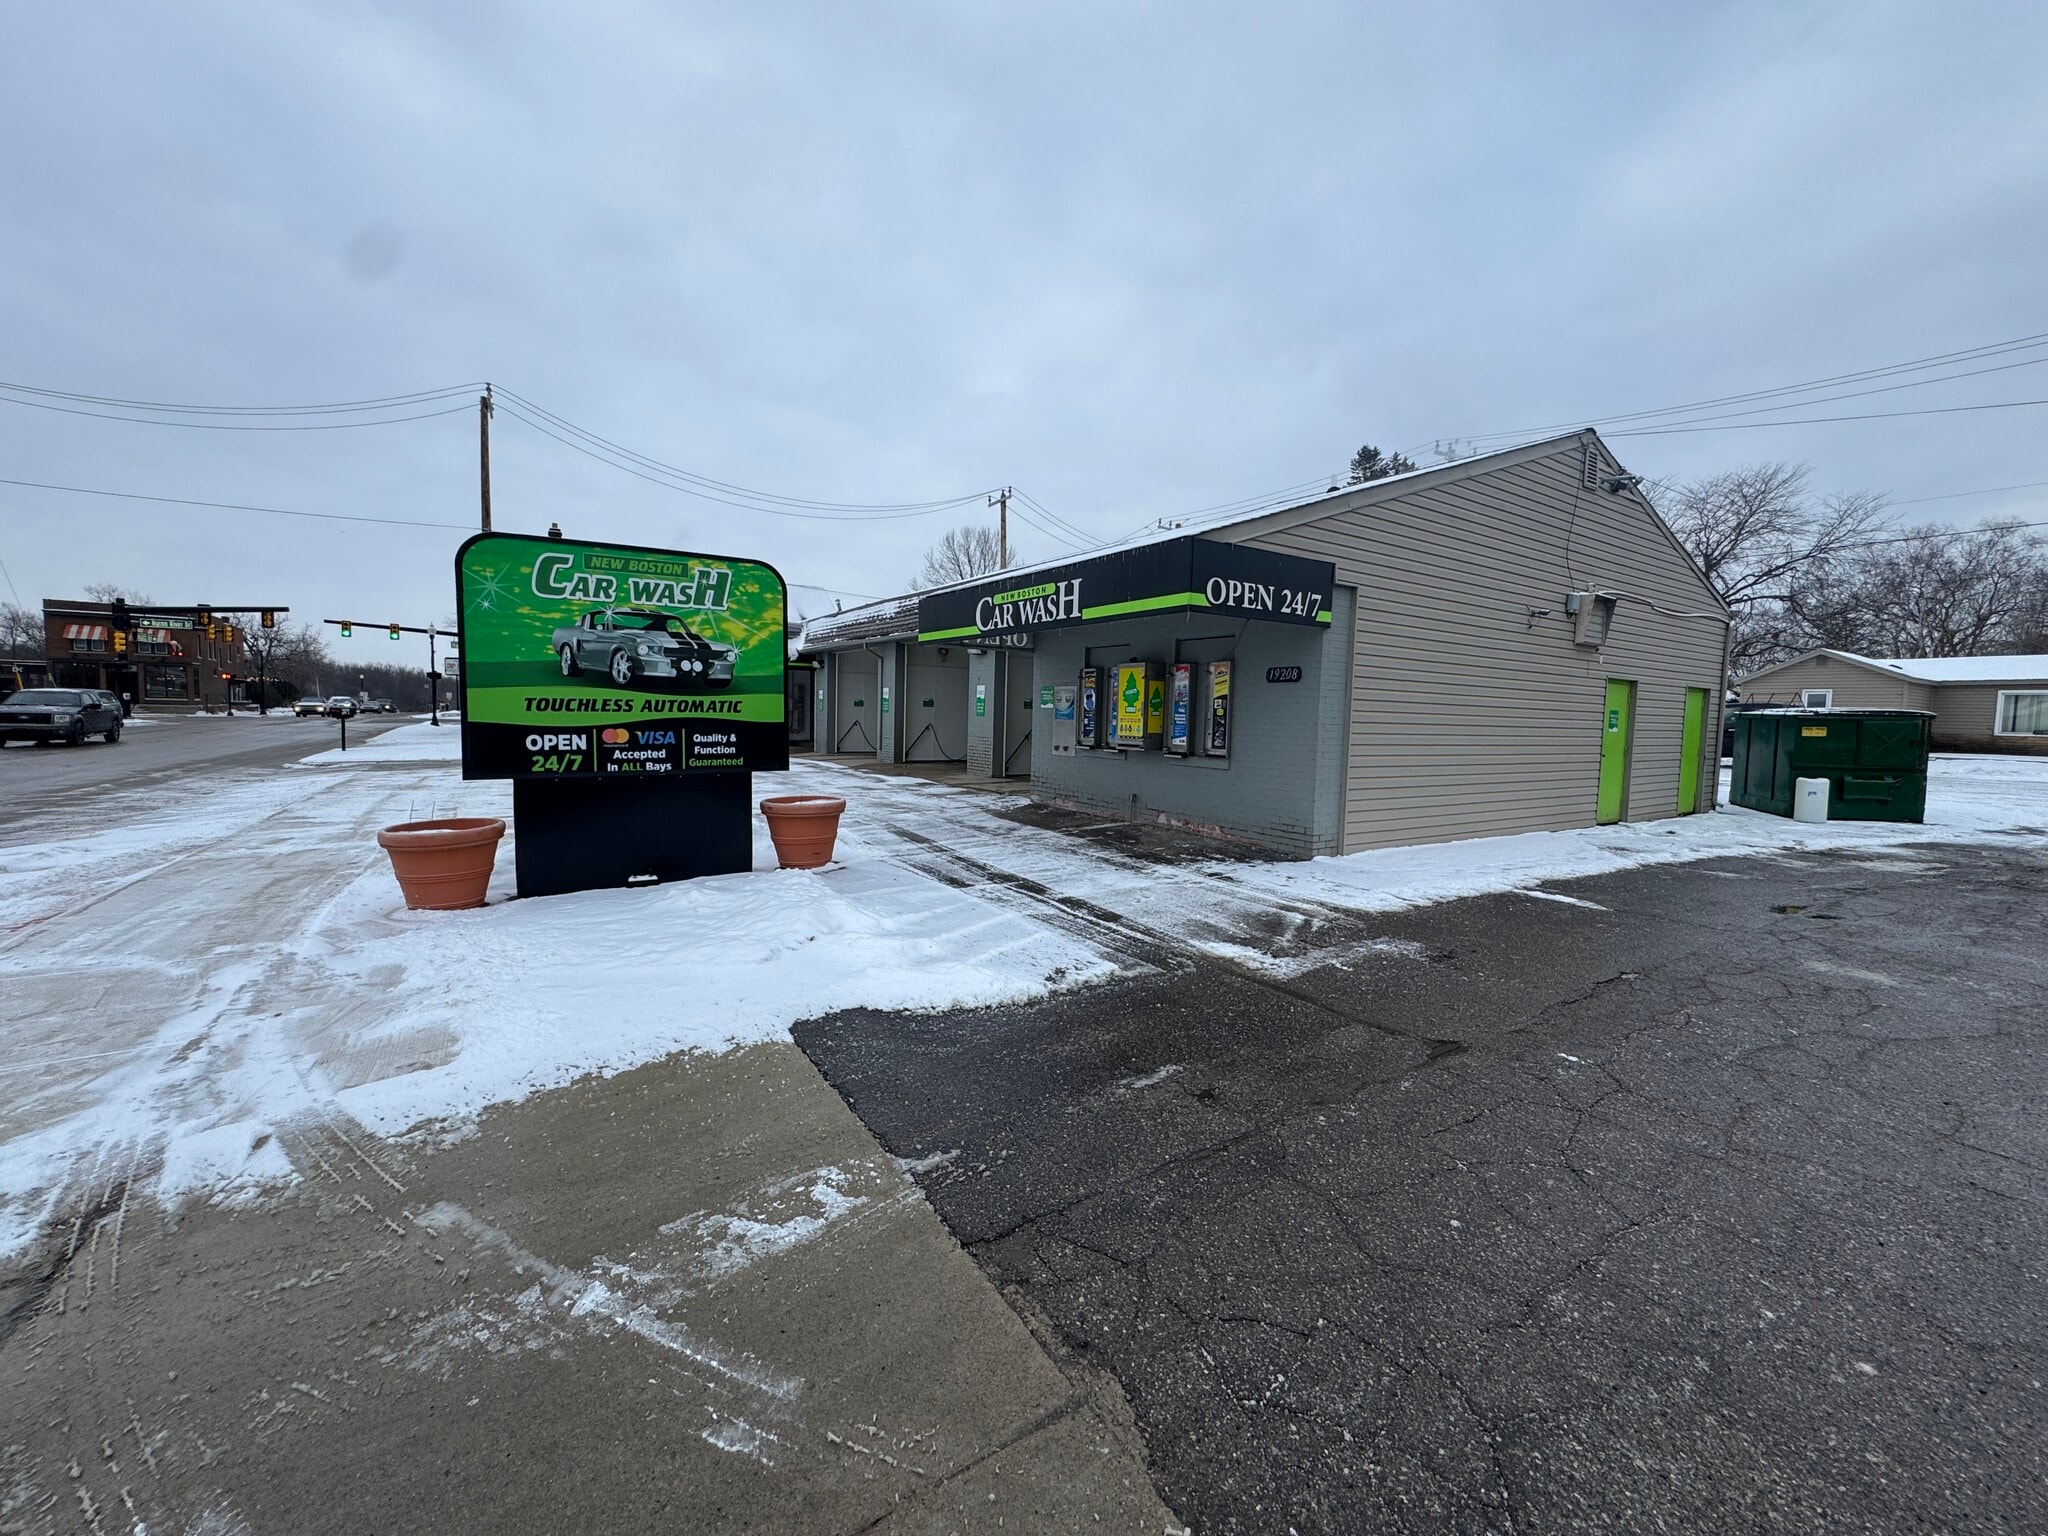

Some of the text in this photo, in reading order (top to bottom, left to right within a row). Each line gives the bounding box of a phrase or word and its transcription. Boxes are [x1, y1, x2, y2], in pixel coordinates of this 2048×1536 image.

[591, 557, 683, 575] NEW BOSTON
[532, 552, 733, 611] CAR WASH
[1000, 587, 1047, 602] NEW BOSTON
[1206, 576, 1322, 618] OPEN 24/7
[975, 578, 1082, 632] CAR WASH
[1269, 668, 1299, 681] 19208
[524, 697, 743, 714] TOUCHLESS AUTOMATIC
[525, 733, 587, 751] OPEN
[634, 731, 676, 745] VISA
[693, 733, 737, 744] Quality &
[613, 748, 666, 760] Accepted
[694, 745, 736, 754] Function
[531, 754, 583, 773] 24/7
[607, 762, 672, 773] In ALL Bays
[689, 757, 744, 768] Guaranteed
